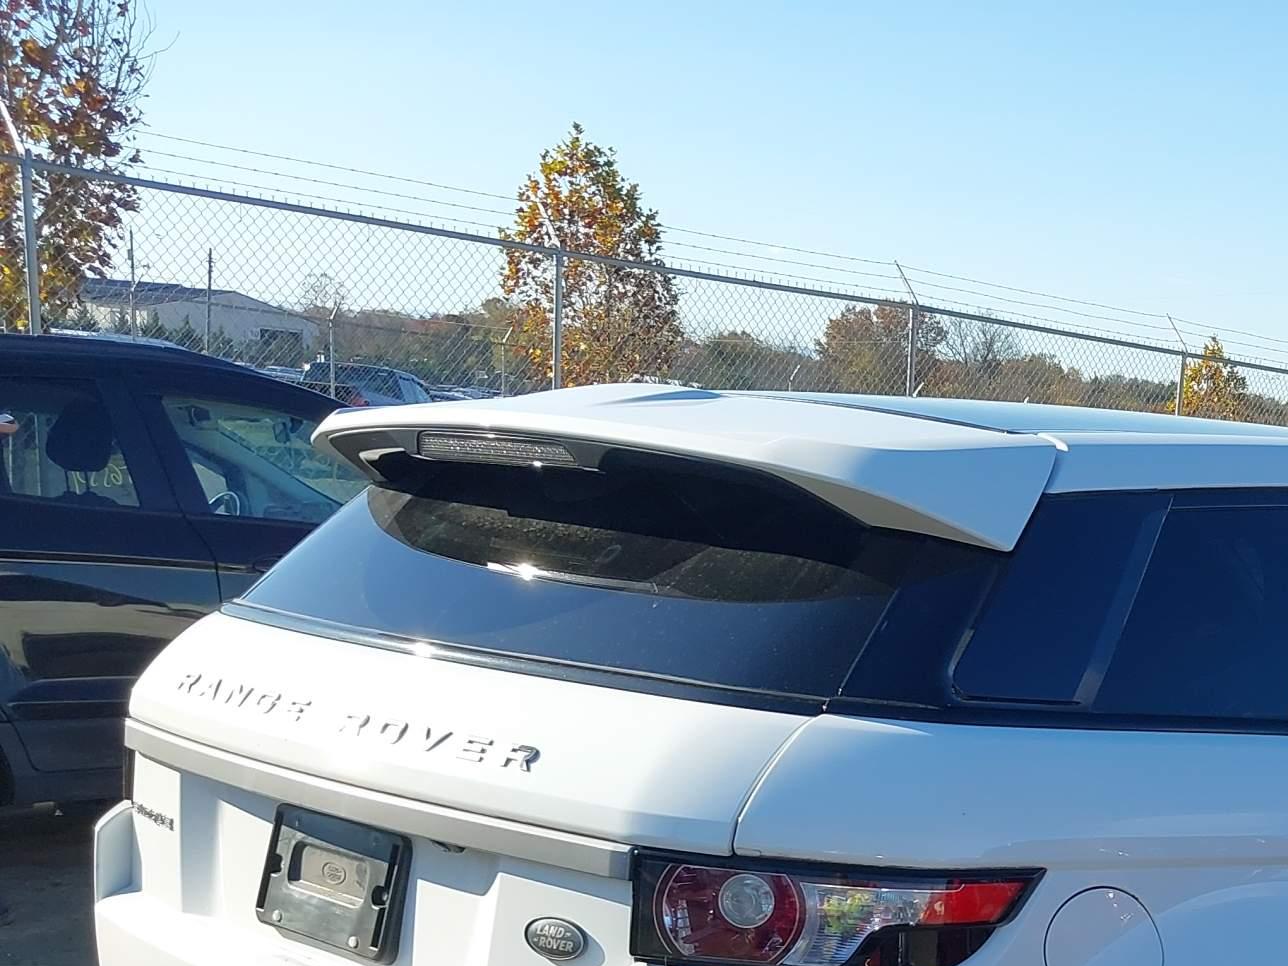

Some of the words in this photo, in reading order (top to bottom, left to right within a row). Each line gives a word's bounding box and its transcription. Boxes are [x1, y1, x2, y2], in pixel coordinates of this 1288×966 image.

[177, 673, 313, 722] RANGE
[338, 713, 542, 772] ROVER
[536, 924, 565, 938] LAND
[539, 936, 574, 952] ROVER
